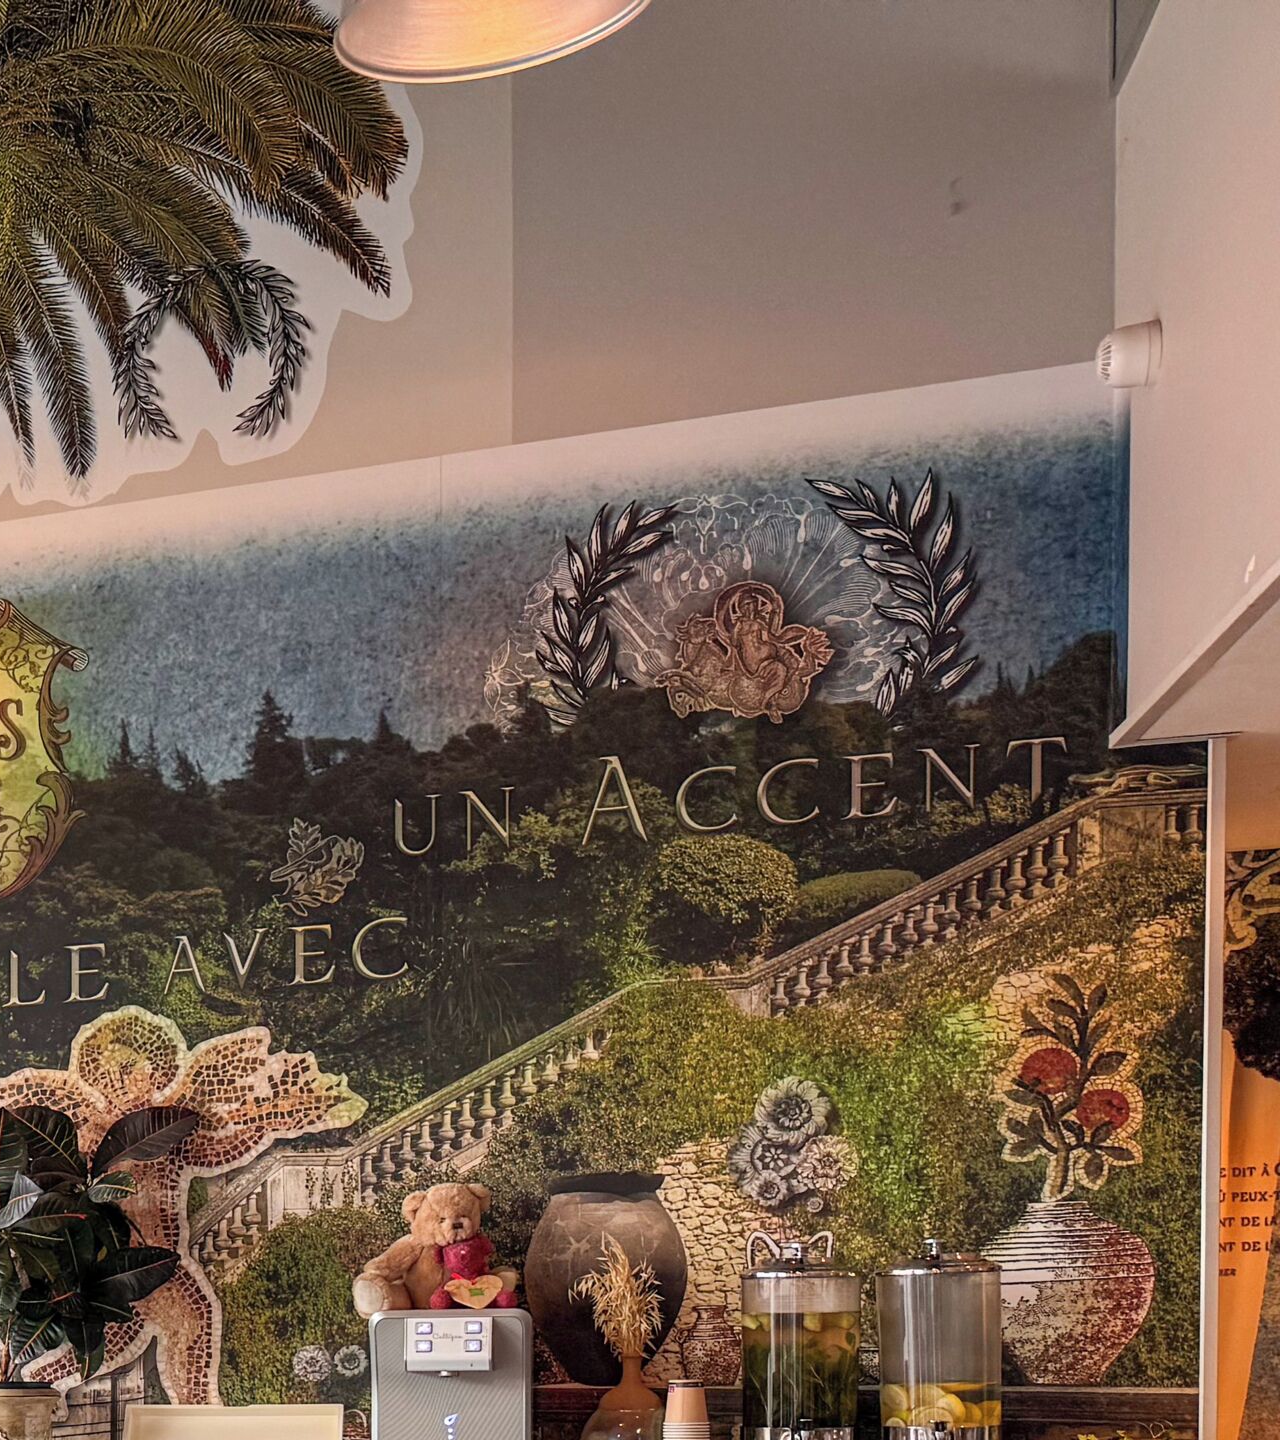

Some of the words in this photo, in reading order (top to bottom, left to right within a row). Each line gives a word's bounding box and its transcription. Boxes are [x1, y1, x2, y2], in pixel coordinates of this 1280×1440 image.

[394, 784, 515, 856] UN
[582, 735, 1068, 847] ACCENT
[164, 916, 410, 994] AVEC
[1231, 1166, 1256, 1178] DIT
[1241, 1216, 1260, 1227] DE
[1241, 1241, 1261, 1252] DE
